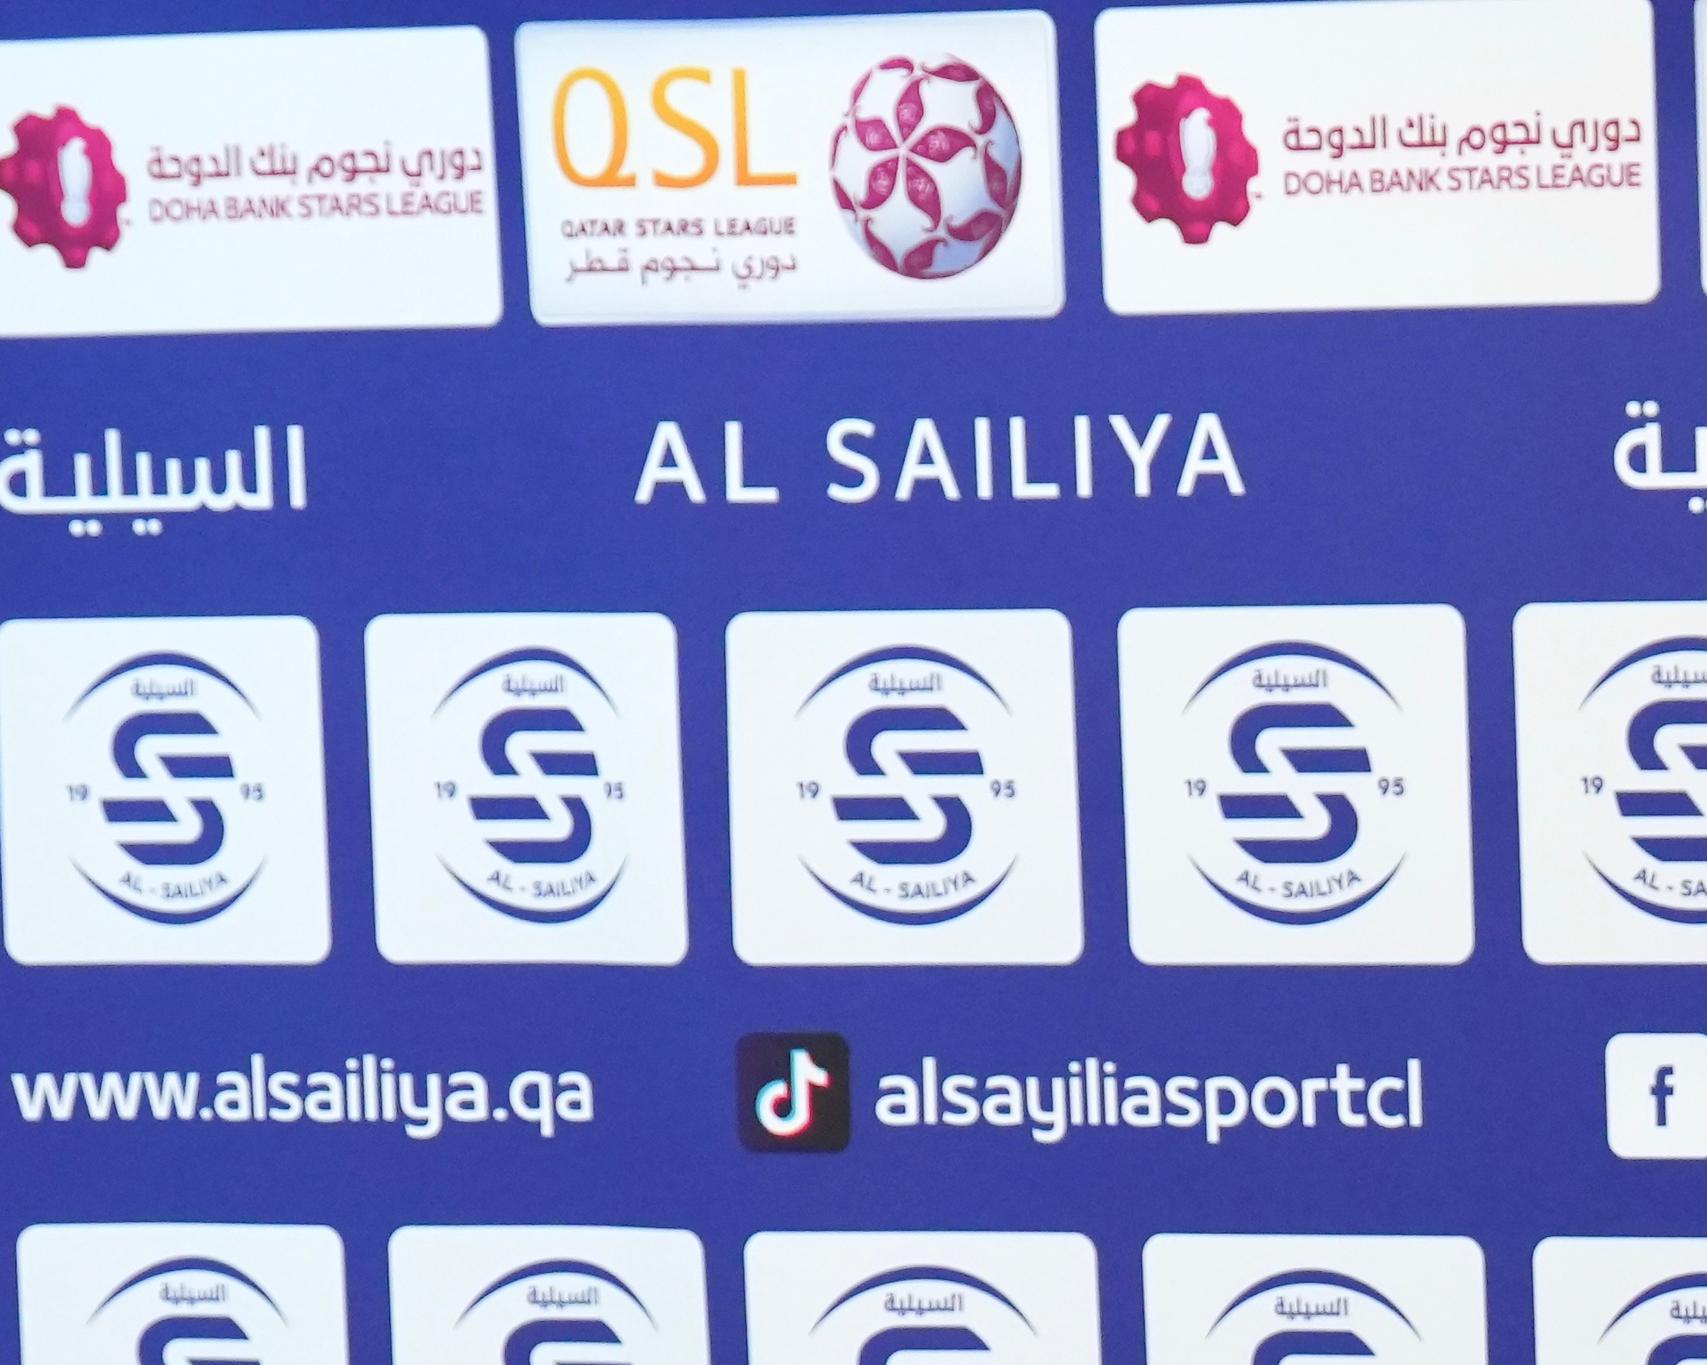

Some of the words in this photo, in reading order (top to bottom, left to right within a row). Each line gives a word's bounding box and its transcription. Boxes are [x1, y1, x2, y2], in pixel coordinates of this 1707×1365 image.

[553, 67, 798, 189] QSL
[1282, 115, 1388, 161] الدوحة
[1396, 114, 1449, 158] بنك
[1456, 112, 1543, 157] نجوم
[1550, 118, 1643, 160] دوري
[146, 146, 242, 189] الدوحة
[249, 145, 299, 186] بنك
[306, 142, 393, 185] نجوم
[399, 147, 484, 189] دوري
[1283, 170, 1365, 197] DOHA
[1369, 168, 1442, 194] BANK
[1446, 165, 1532, 193] STARS
[1535, 162, 1642, 190] LEAGUE
[150, 198, 221, 224] DOHA
[224, 196, 291, 221] BANK
[297, 193, 382, 219] STARS
[385, 190, 484, 218] LEAGUE
[562, 220, 626, 239] QATAR
[637, 219, 705, 238] STARS
[715, 218, 796, 237] LEAGUE
[564, 245, 633, 285] قطر
[640, 248, 721, 289] نجوم
[731, 246, 799, 290] دوري
[635, 421, 778, 503] AL
[827, 413, 1244, 502] SAILIYA
[0, 425, 305, 536] السيلية
[11, 1054, 593, 1138] www.alsailiya.qa
[876, 1057, 1422, 1143] alsayiliasportcl
